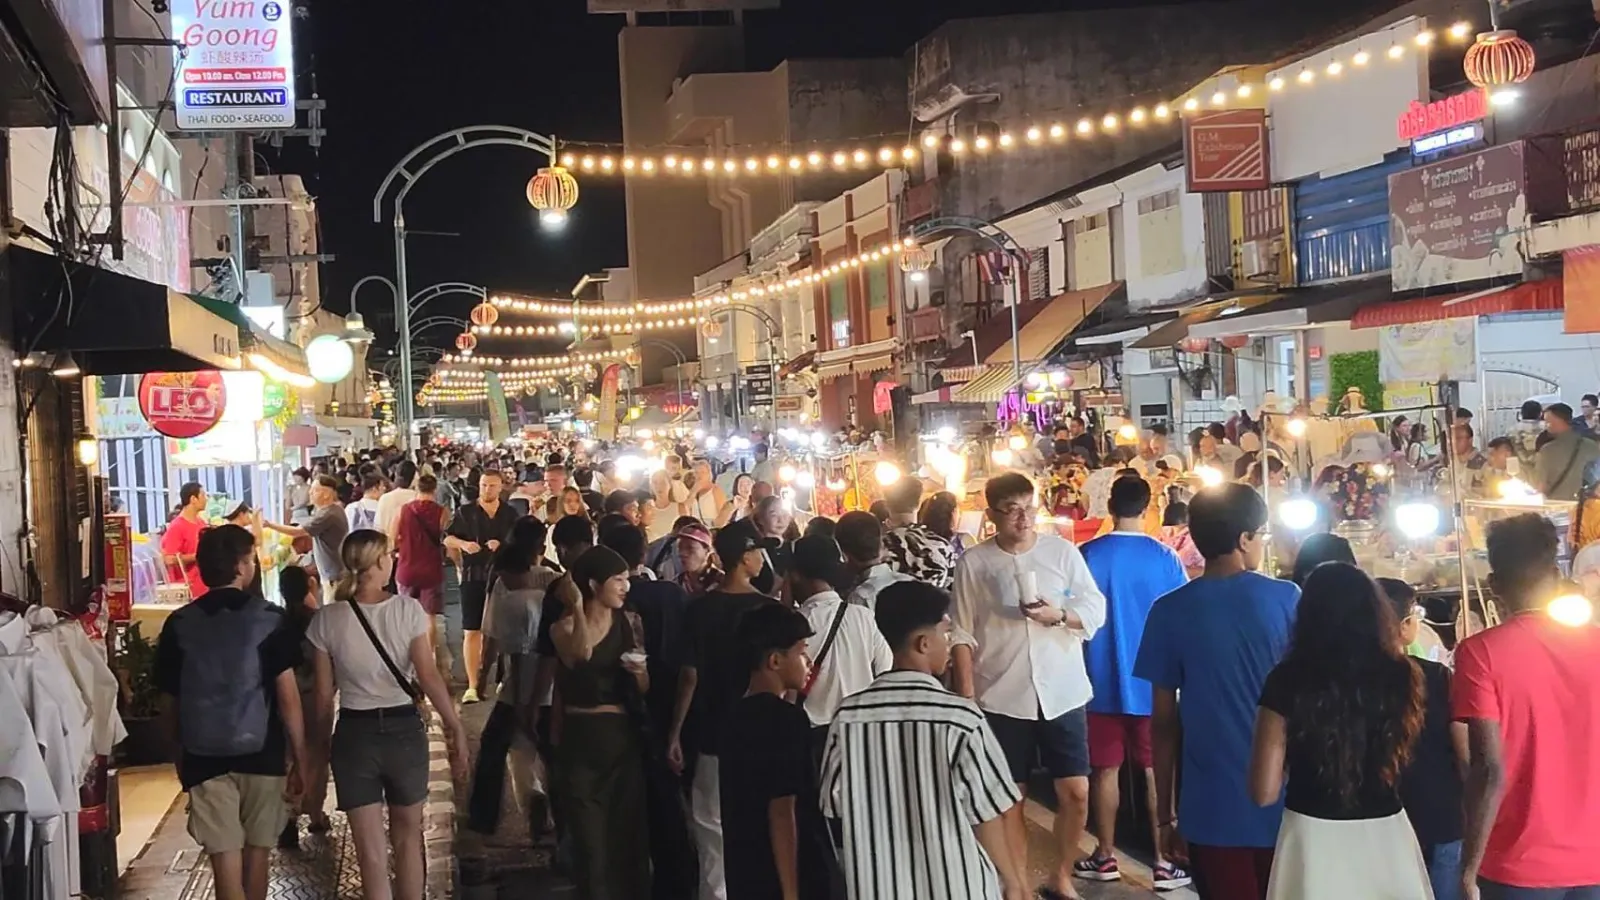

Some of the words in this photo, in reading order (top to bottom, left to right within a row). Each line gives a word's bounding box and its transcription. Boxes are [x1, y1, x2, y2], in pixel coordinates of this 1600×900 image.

[194, 0, 255, 18] Yum
[184, 24, 278, 52] Goong
[185, 72, 202, 82] Open
[202, 72, 222, 80] 10.00
[252, 71, 272, 80] 12.00
[189, 91, 284, 105] RESTAURANT
[188, 115, 208, 124] THAI
[211, 115, 235, 123] FOOD
[243, 113, 284, 123] SEAFOOD
[152, 388, 211, 414] LEO
